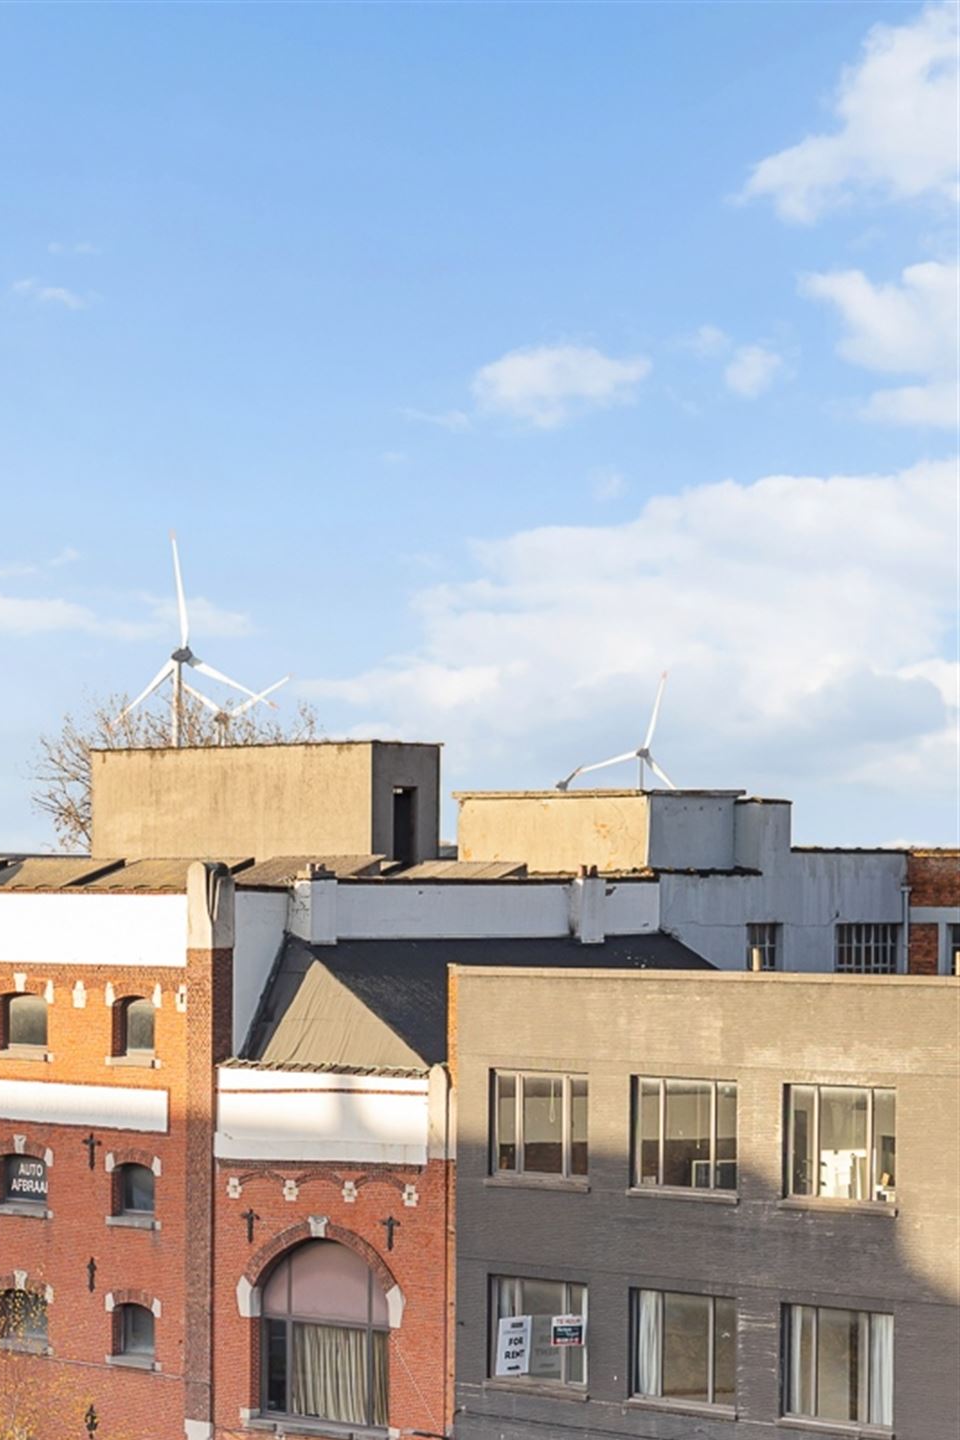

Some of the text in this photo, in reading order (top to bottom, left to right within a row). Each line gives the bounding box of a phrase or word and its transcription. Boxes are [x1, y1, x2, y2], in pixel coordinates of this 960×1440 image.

[18, 1163, 43, 1177] AUTO
[508, 1336, 524, 1346] FOR
[504, 1349, 525, 1360] RENT
